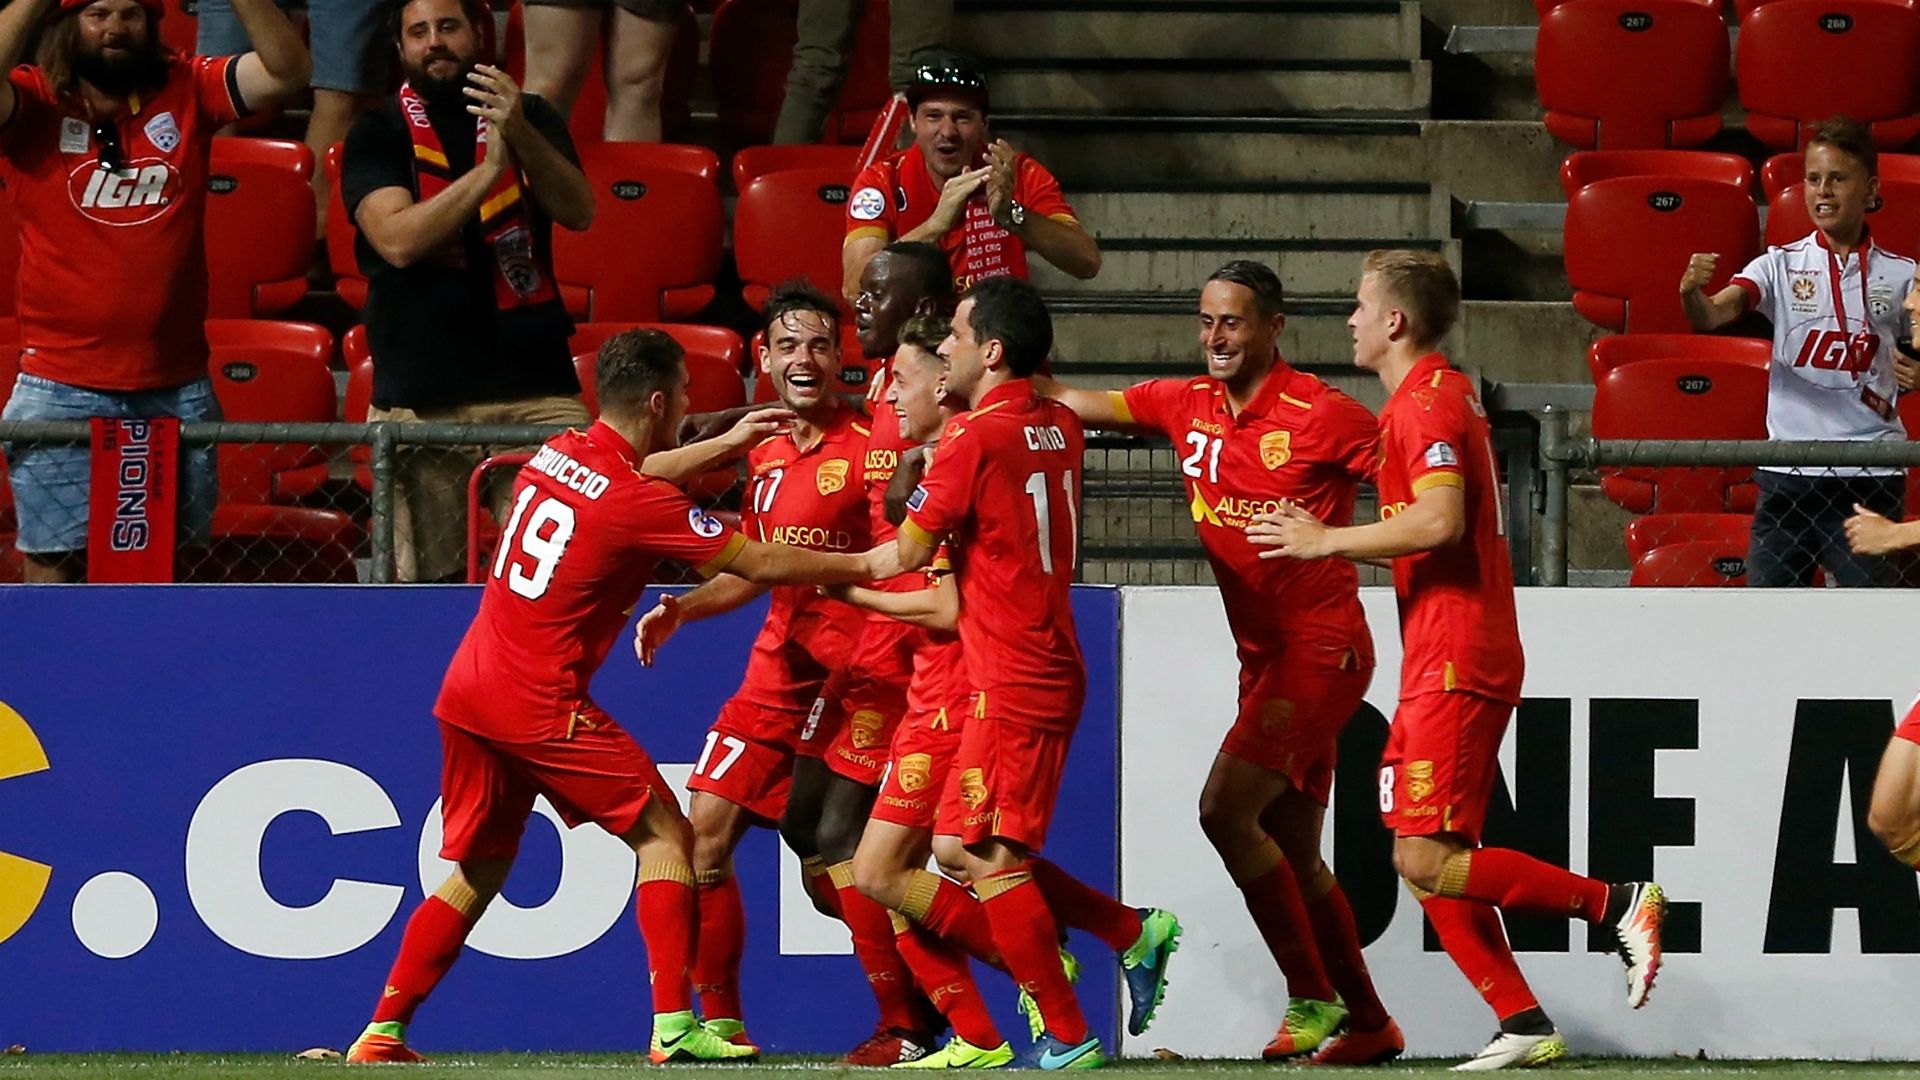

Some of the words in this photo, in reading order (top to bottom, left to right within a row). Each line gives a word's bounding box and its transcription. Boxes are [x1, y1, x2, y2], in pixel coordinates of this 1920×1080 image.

[1626, 17, 1645, 27] 267
[80, 165, 169, 208] IGA
[1655, 196, 1674, 207] 267
[844, 371, 863, 381] 263
[1685, 380, 1704, 390] 267
[1182, 430, 1223, 484] 21
[111, 419, 150, 551] PIONS
[752, 467, 784, 515] 17
[493, 484, 576, 600] 19
[772, 526, 850, 550] AUSGOLD
[1025, 469, 1078, 575] 11
[1722, 562, 1741, 572] 267
[694, 730, 747, 781] 17
[1379, 765, 1395, 813] 8
